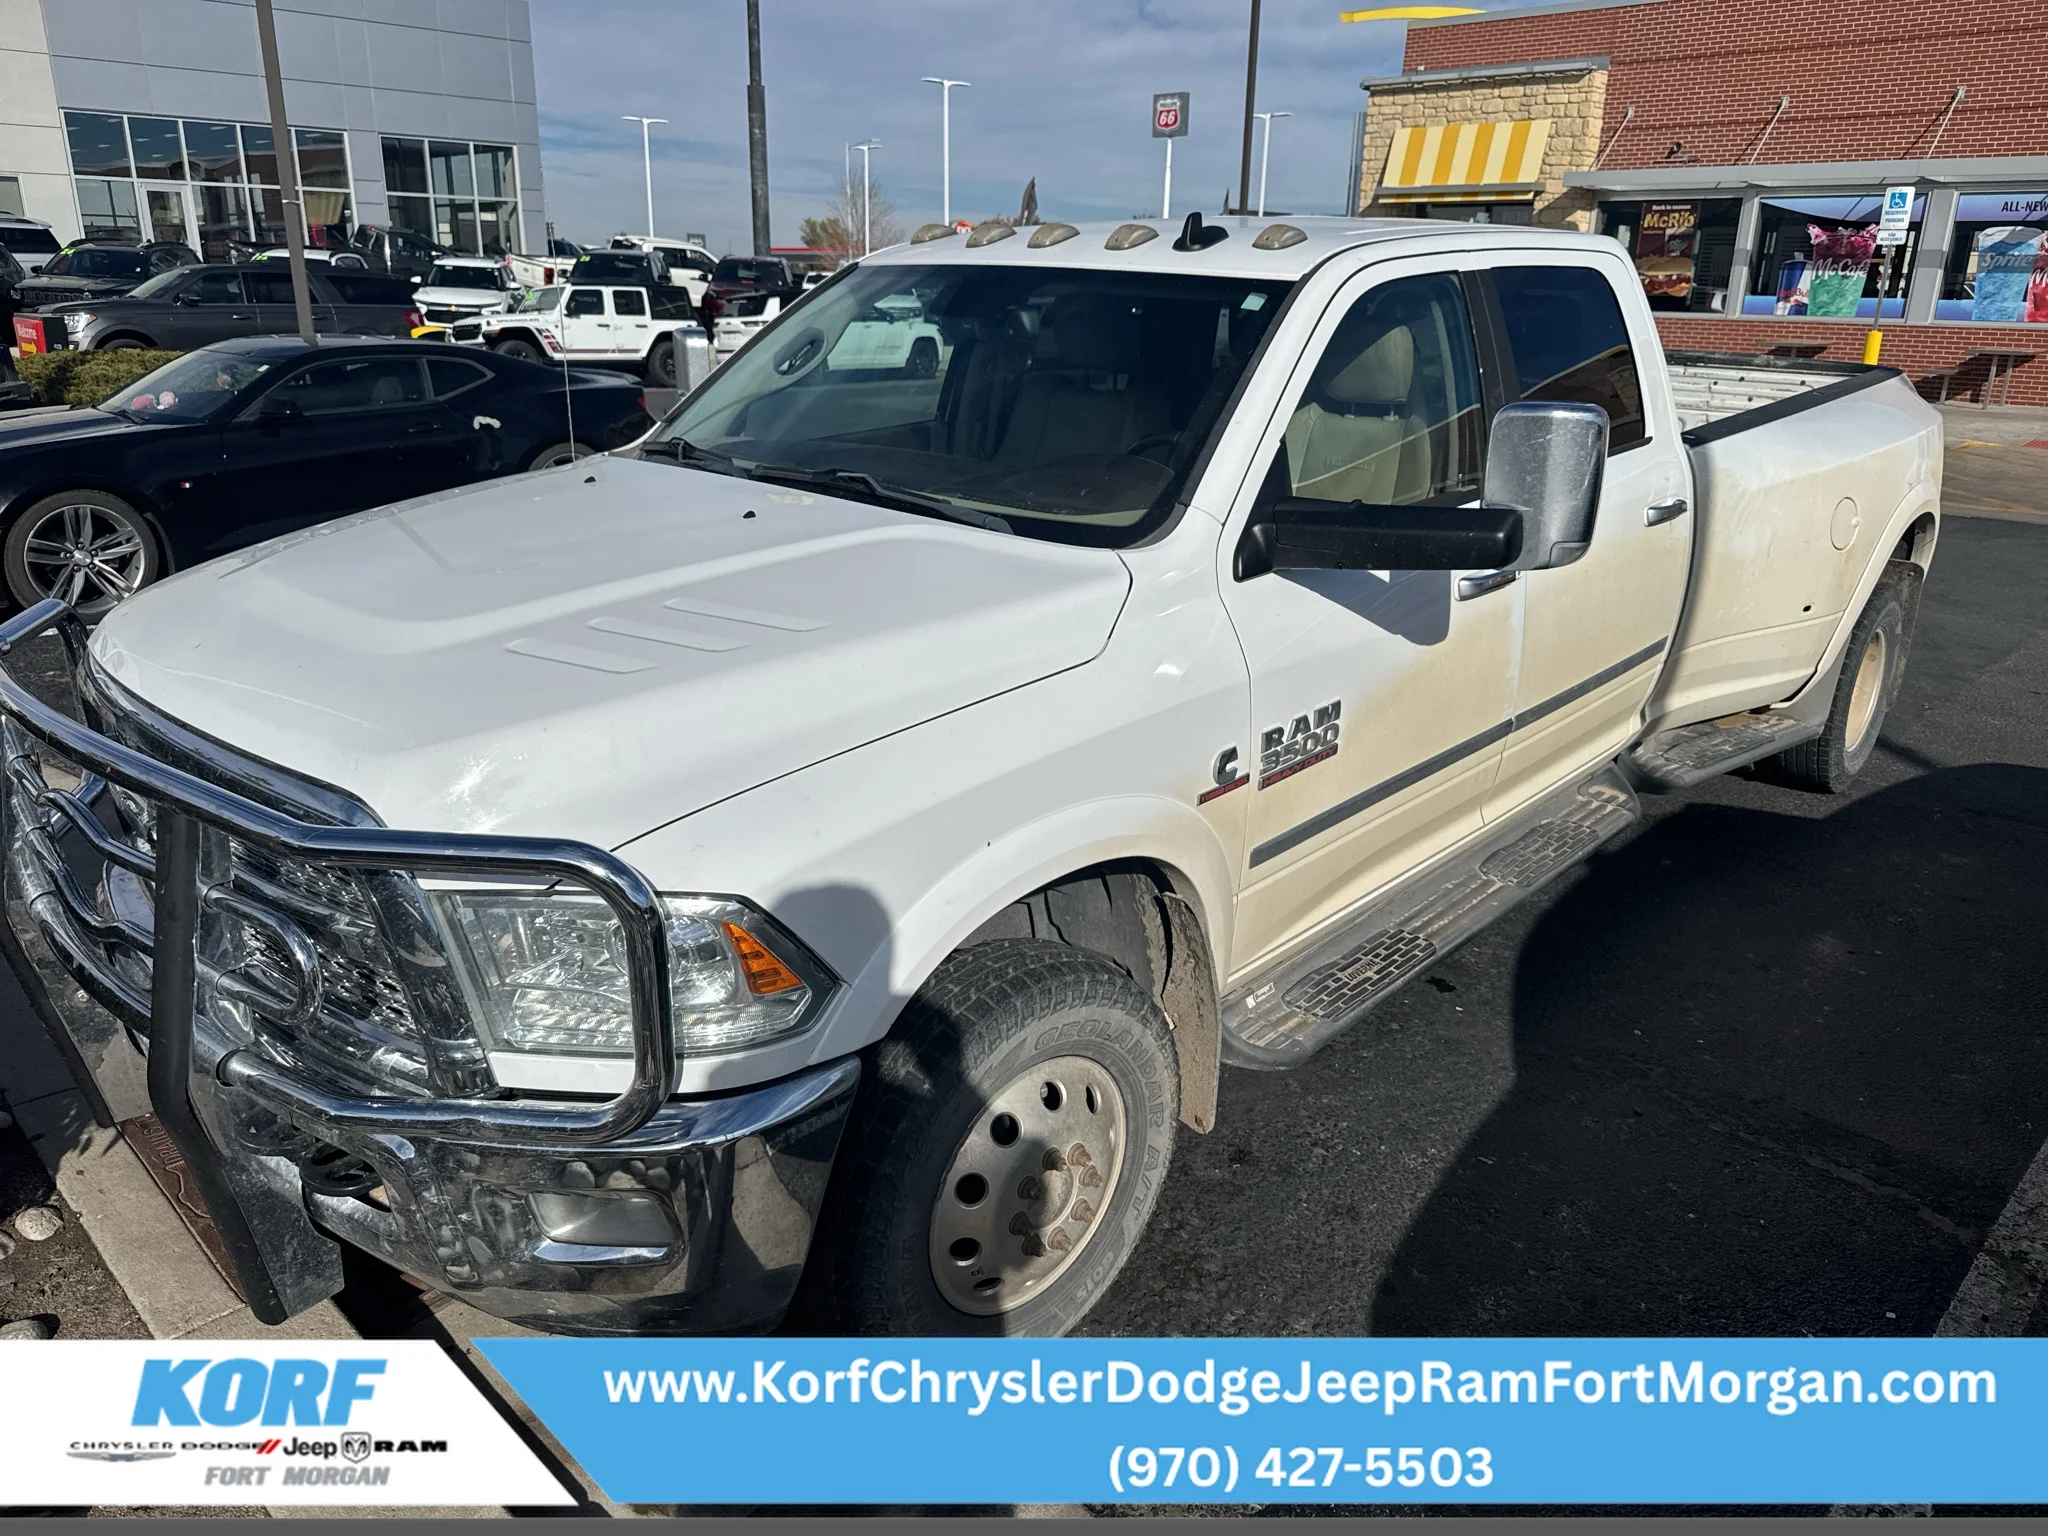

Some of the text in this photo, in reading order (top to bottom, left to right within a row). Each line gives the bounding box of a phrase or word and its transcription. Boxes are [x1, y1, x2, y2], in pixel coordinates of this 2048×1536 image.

[1159, 111, 1176, 126] 66
[2000, 200, 2048, 213] ALL-NEW
[1643, 211, 1695, 228] McRib
[1980, 252, 2033, 276] Sprite
[15, 322, 38, 340] Welcome
[1260, 699, 1342, 755] RAM
[1259, 722, 1340, 776] 3500
[1263, 747, 1336, 787] HEAVY DUTY
[1344, 959, 1380, 982] LUVERNE
[1034, 1018, 1165, 1128] GEOLANDAR
